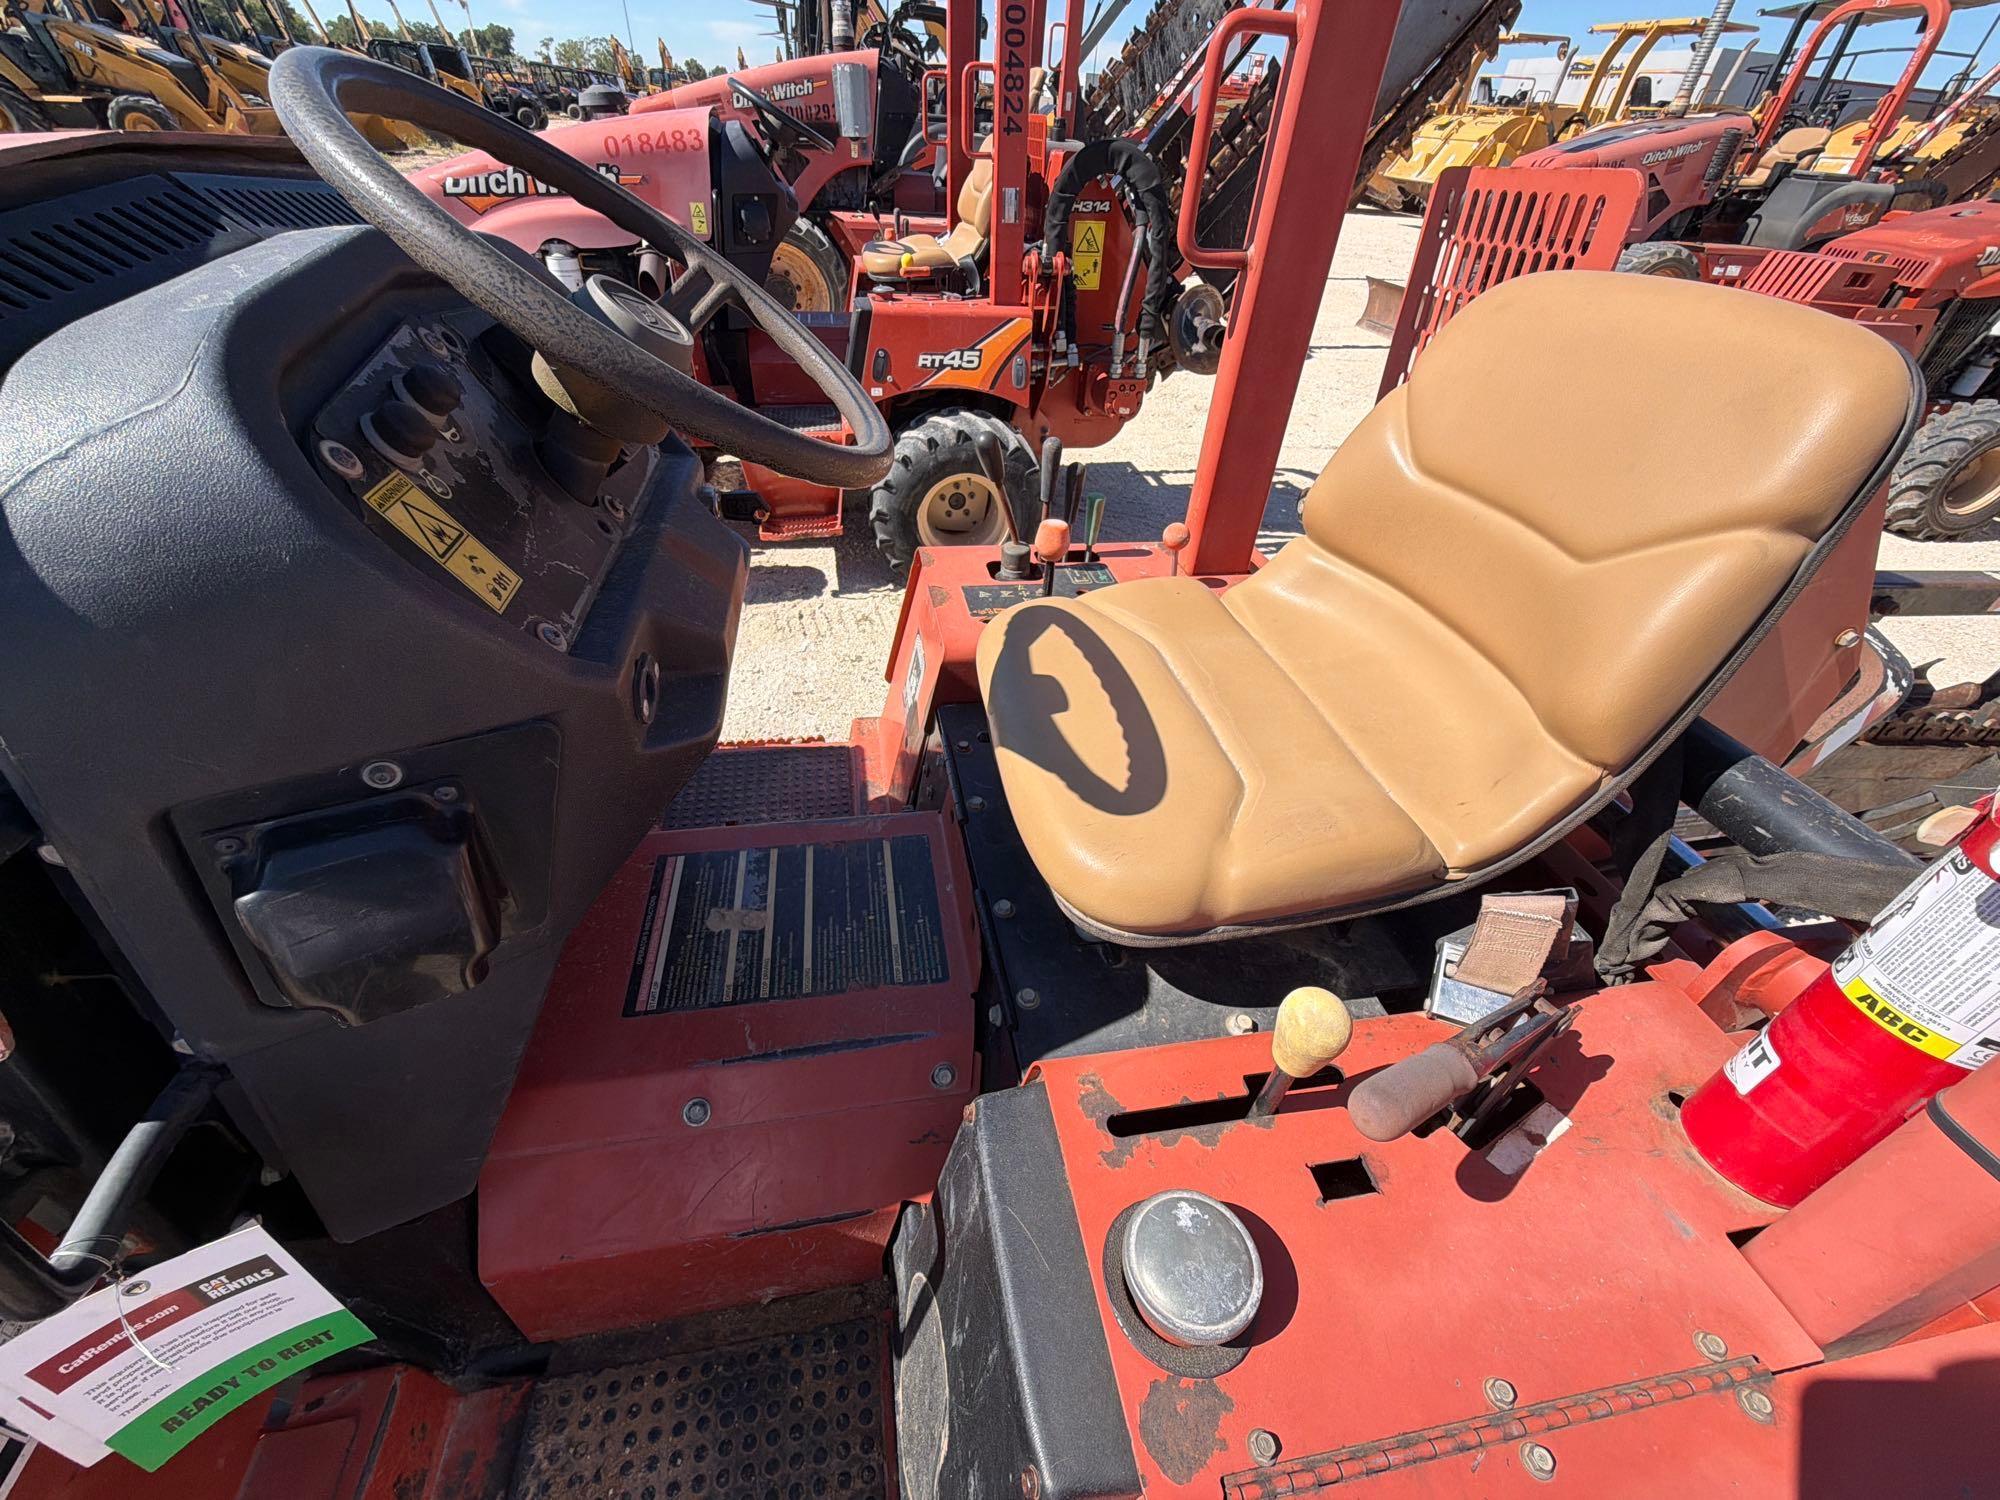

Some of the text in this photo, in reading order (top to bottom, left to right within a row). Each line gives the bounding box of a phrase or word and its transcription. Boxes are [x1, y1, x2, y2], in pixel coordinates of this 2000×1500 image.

[1003, 4, 1026, 136] 004824
[772, 79, 813, 102] Witch
[604, 129, 704, 158] 018483
[1642, 148, 1673, 165] Ditch
[1674, 140, 1704, 158] Witch
[445, 167, 525, 194] Ditch
[918, 350, 980, 369] RT45
[380, 478, 410, 507] WARNING
[1856, 994, 1929, 1042] ABC
[199, 1275, 230, 1293] CAT
[207, 1268, 275, 1299] RENTALS
[229, 1310, 274, 1334] equipment
[58, 1304, 180, 1374] CatRentas.com
[83, 1381, 107, 1396] This
[178, 1325, 202, 1339] been
[203, 1305, 245, 1326] inspected
[245, 1299, 259, 1307] for
[92, 1386, 111, 1401] and
[112, 1365, 144, 1387] proper
[146, 1338, 190, 1365] oeration
[191, 1323, 221, 1340] before
[116, 1376, 139, 1392] your
[140, 1339, 200, 1376] resonsibility
[213, 1316, 247, 1337] perform
[160, 1329, 335, 1434] READY TO RENT
[119, 1397, 150, 1417] Thank
